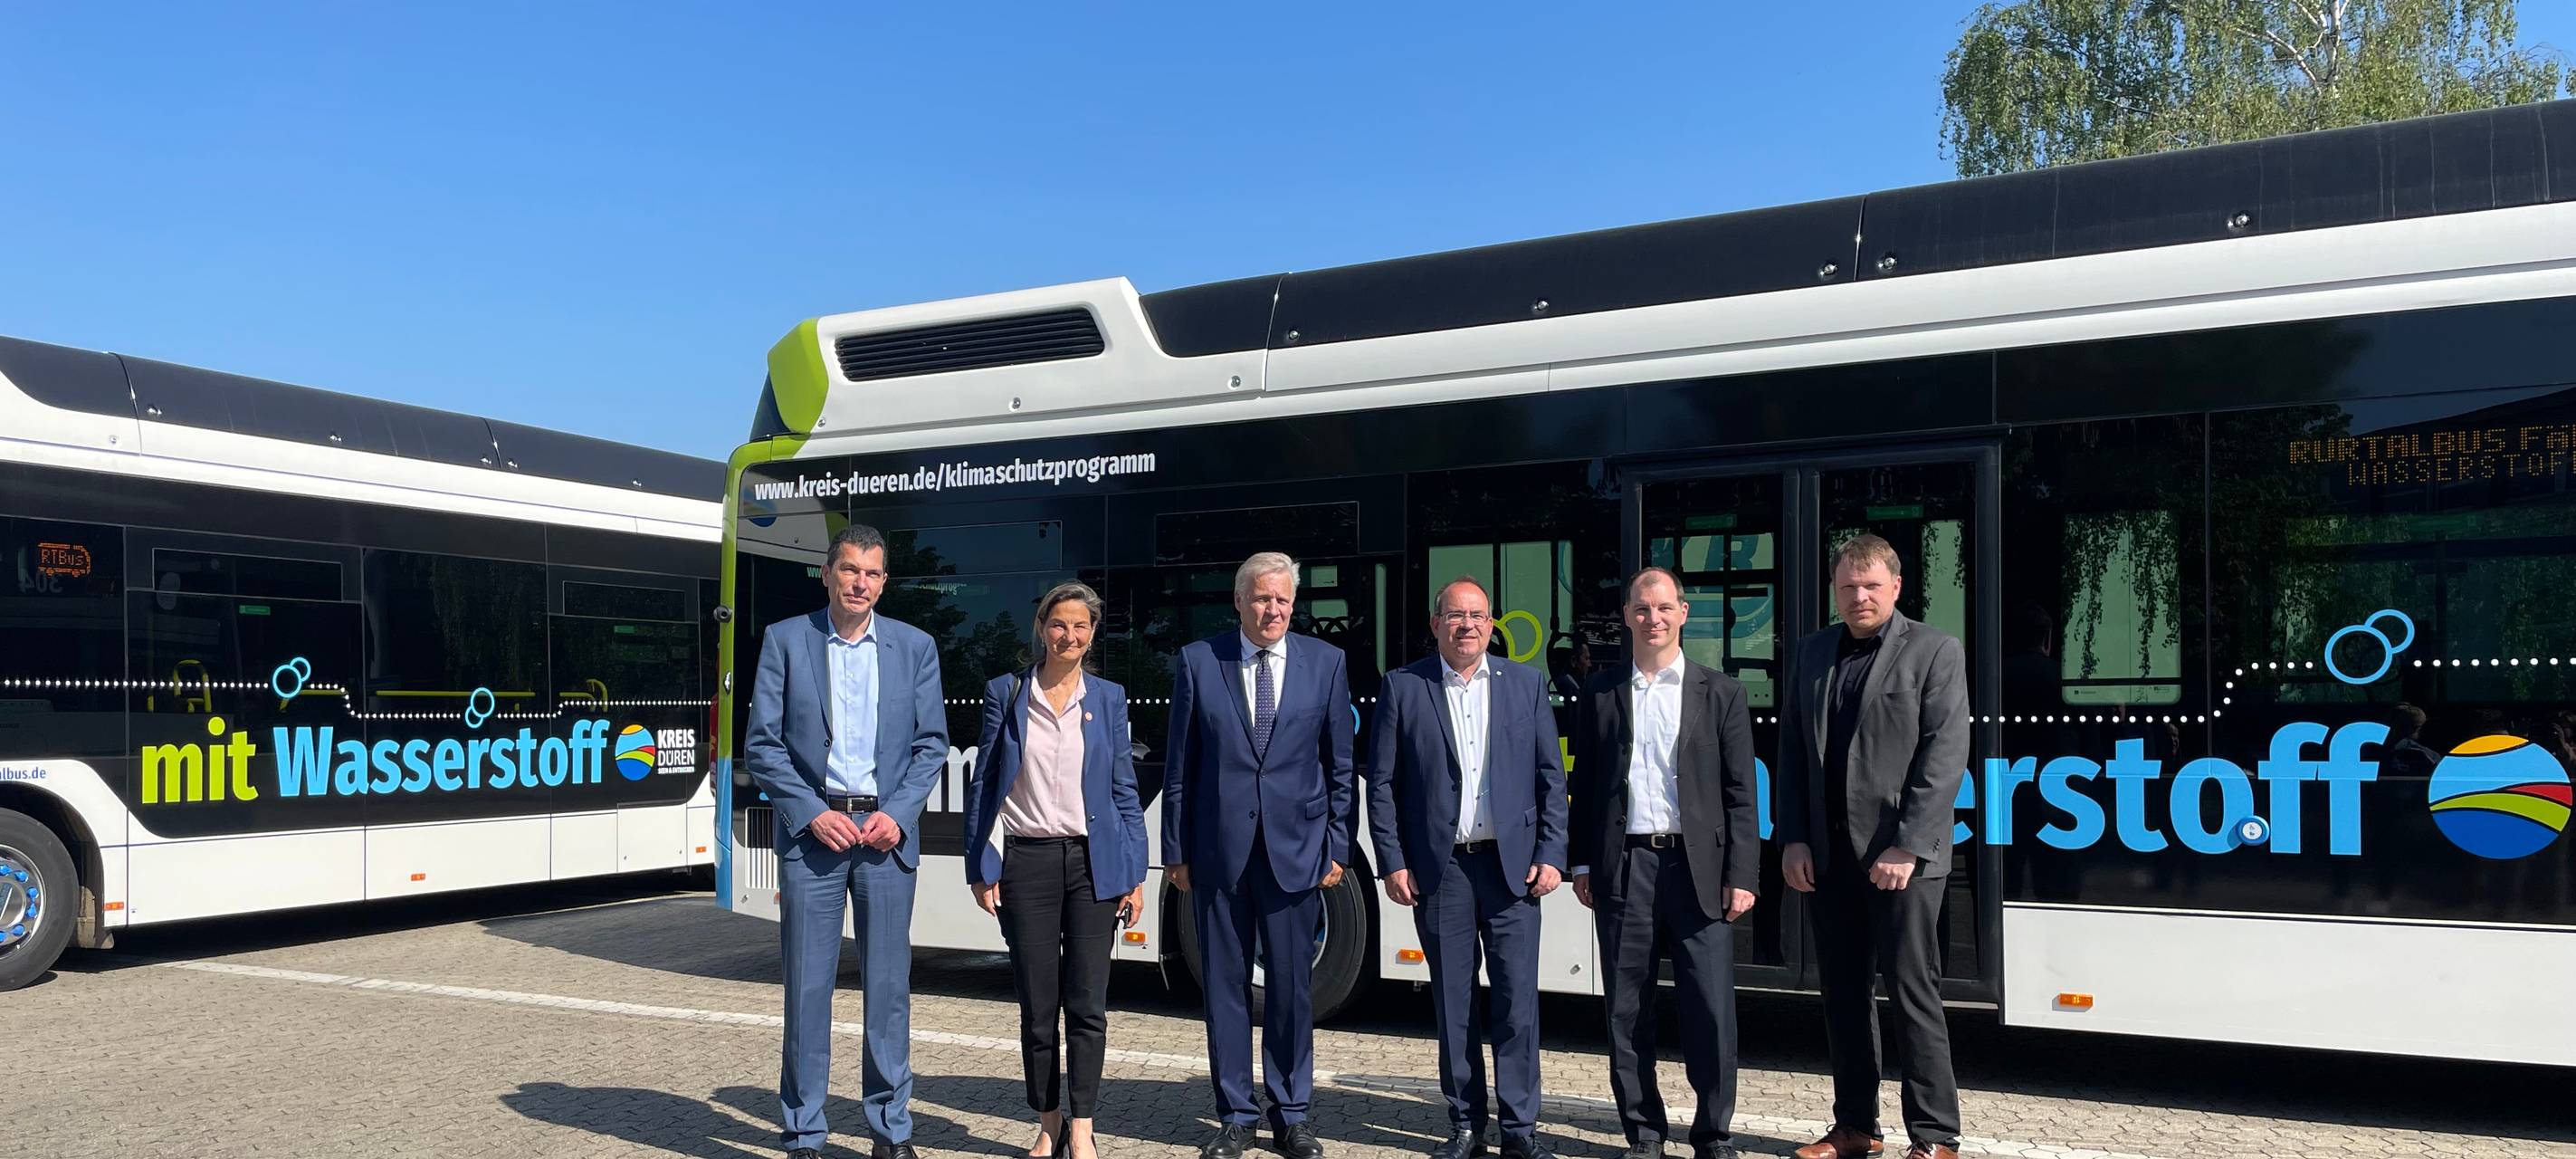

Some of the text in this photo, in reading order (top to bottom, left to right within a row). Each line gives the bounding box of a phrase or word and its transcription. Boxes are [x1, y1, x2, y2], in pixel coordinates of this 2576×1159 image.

[2289, 423, 2576, 465] RURTALBUS FÄ
[754, 452, 1156, 501] www.kreis-dueren.de/klimaschutzprogramm
[41, 548, 84, 566] RTBus
[657, 729, 695, 749] KREIS
[141, 716, 611, 804] mit Wasserstoff
[657, 749, 695, 767] DÜREN
